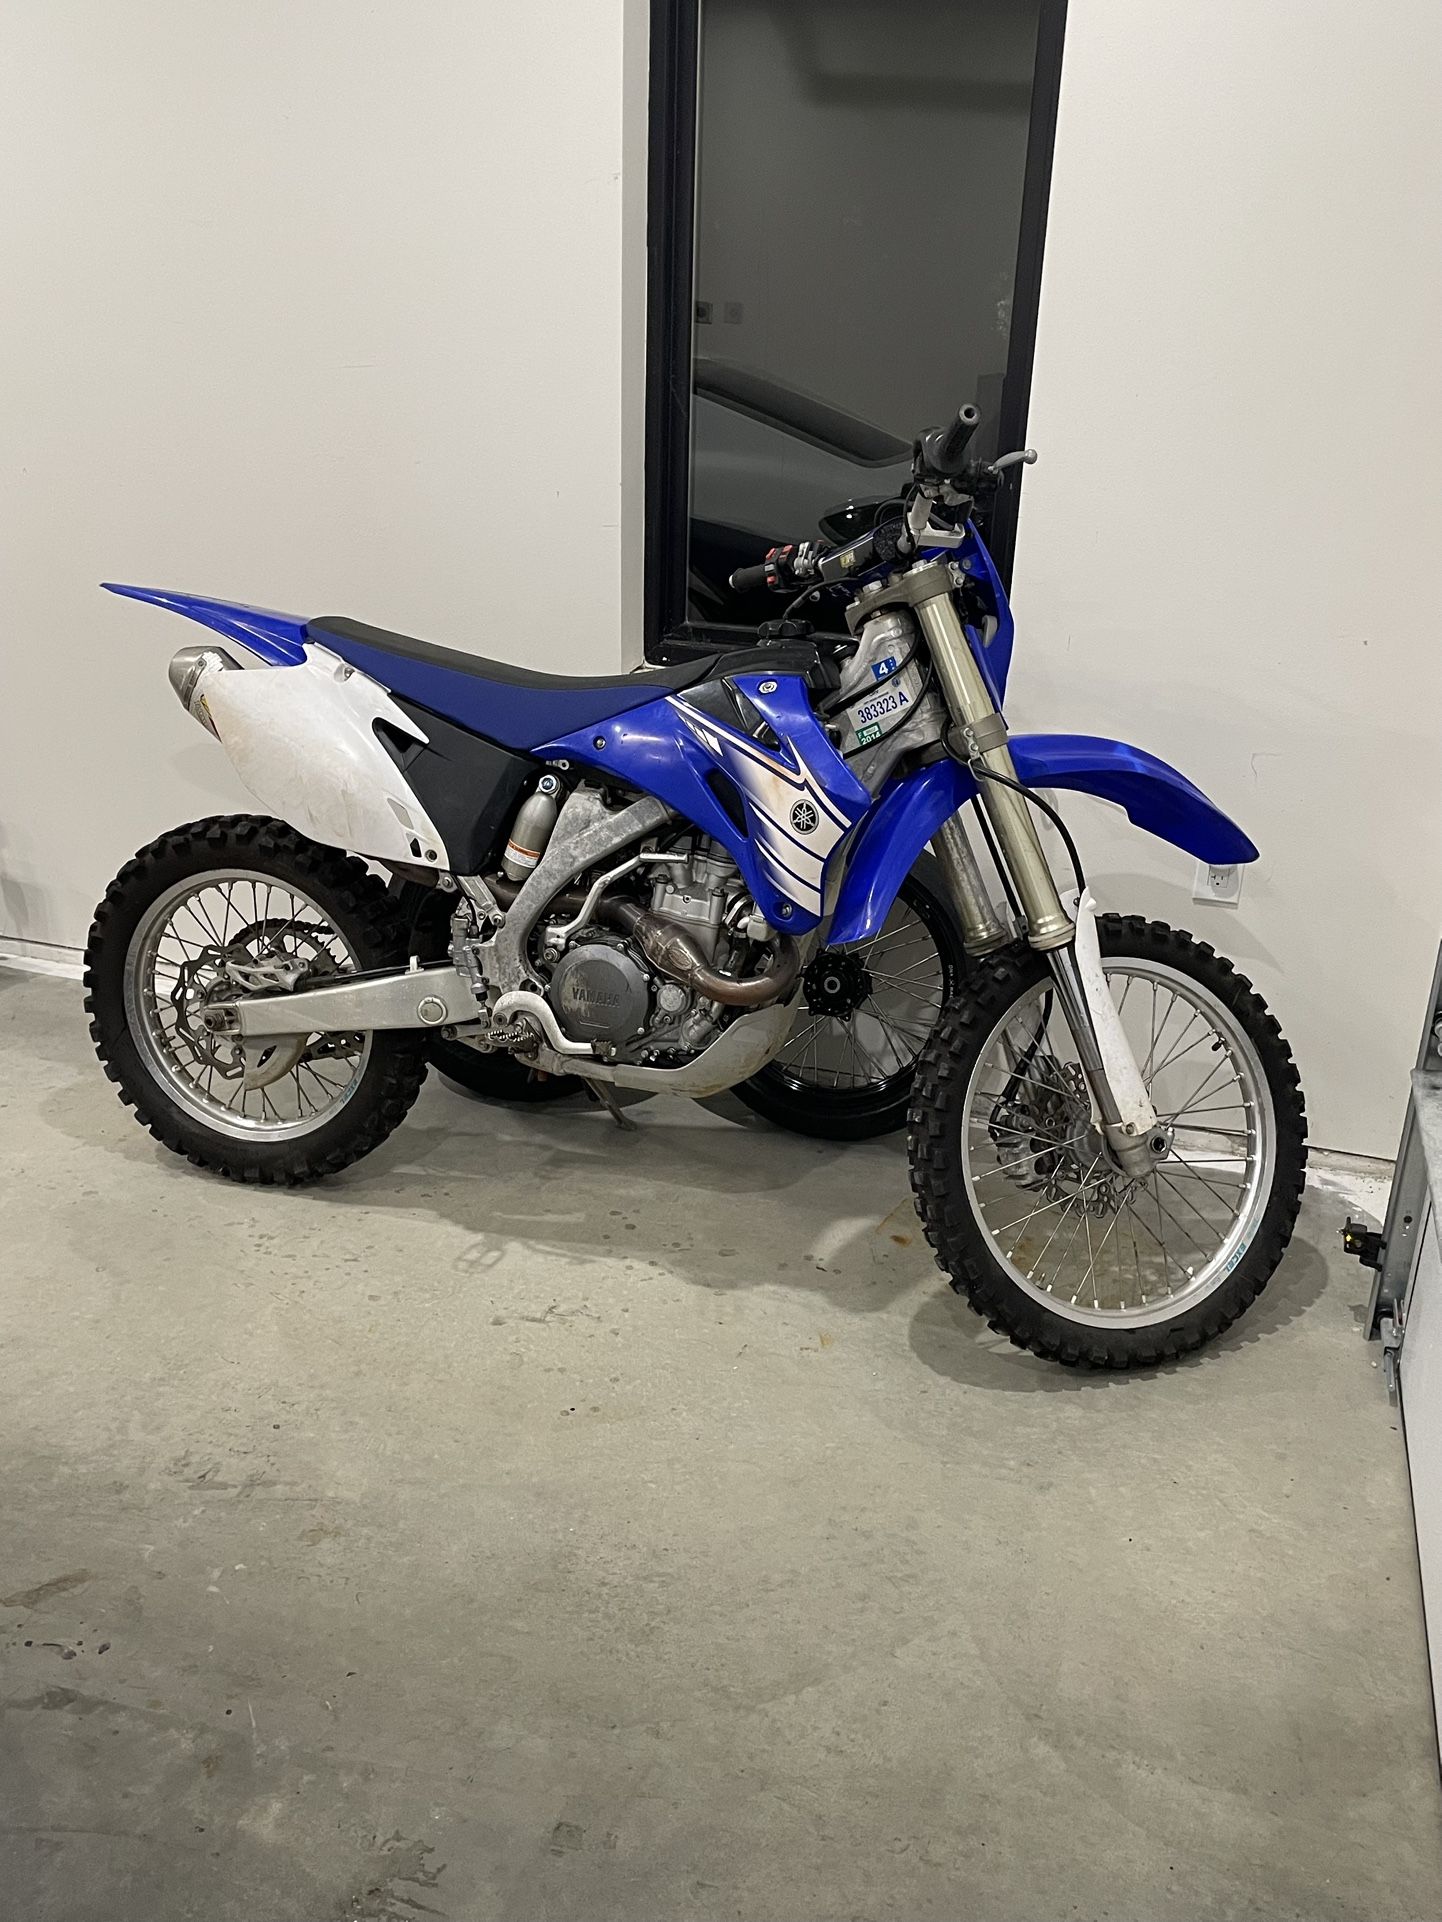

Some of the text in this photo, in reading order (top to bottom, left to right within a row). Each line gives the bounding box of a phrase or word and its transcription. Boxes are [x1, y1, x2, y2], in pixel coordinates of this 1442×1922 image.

[879, 662, 889, 675] 4
[858, 695, 898, 724] 383323
[898, 691, 909, 706] A
[860, 731, 881, 746] 2014
[572, 986, 620, 1006] YAMAHA
